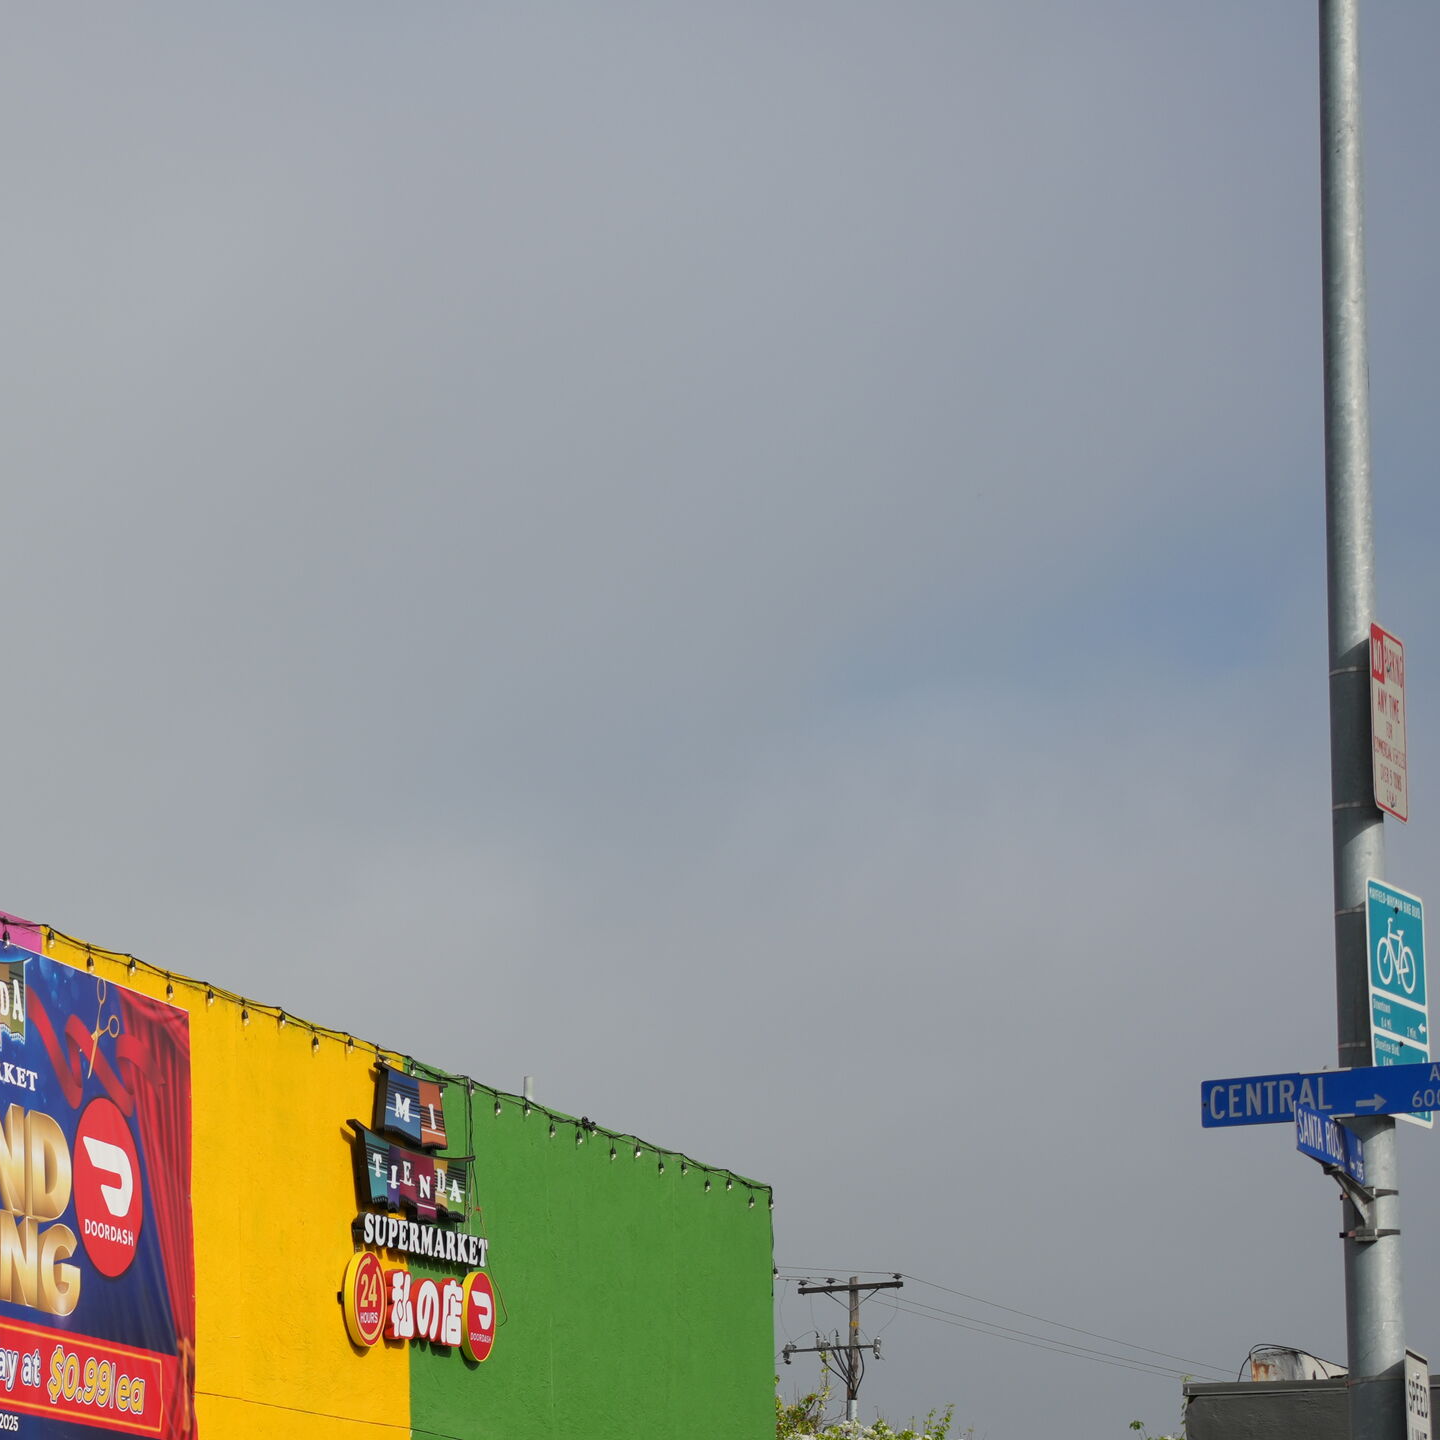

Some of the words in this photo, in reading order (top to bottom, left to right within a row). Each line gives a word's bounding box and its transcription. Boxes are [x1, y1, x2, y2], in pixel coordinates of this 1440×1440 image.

[1372, 636, 1383, 676] NO
[1377, 686, 1387, 715] ANY
[1388, 693, 1400, 724] TIME
[394, 1093, 437, 1131] MI
[1209, 1076, 1333, 1120] CENTRAL
[1297, 1108, 1324, 1152] SANTA
[372, 1152, 463, 1204] TIENDA
[83, 1218, 135, 1247] DOORDASH
[363, 1212, 489, 1268] SUPERMARKET
[360, 1273, 378, 1309] 24
[391, 1271, 464, 1346] 私の店
[360, 1311, 379, 1324] HOURS
[470, 1332, 493, 1344] DOORDASH
[22, 1348, 42, 1388] at
[1408, 1378, 1428, 1419] SPEED
